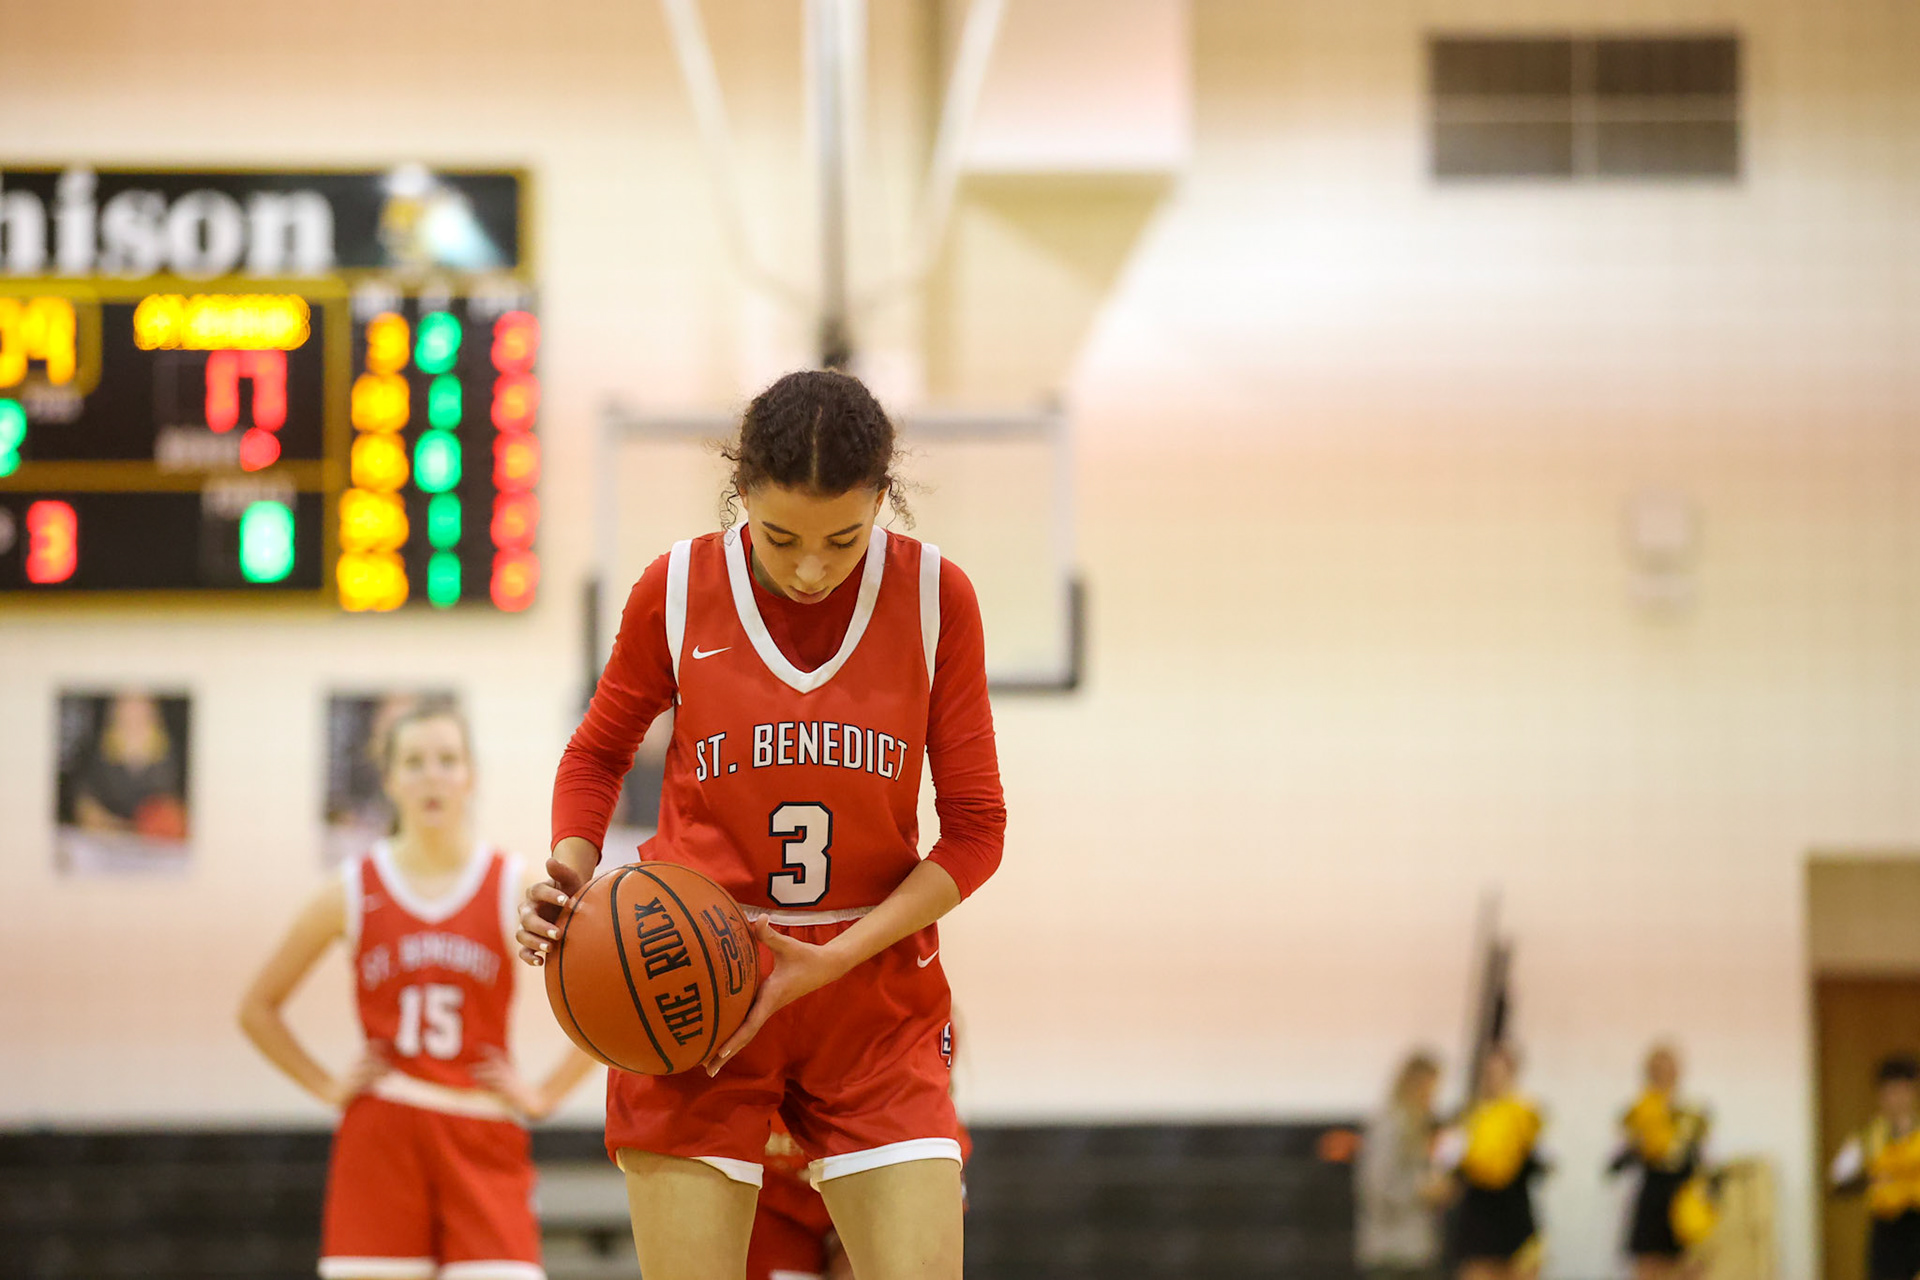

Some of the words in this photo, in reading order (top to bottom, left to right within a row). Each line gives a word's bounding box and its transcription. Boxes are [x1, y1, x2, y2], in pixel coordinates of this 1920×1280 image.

[695, 731, 738, 782] ST.
[752, 720, 908, 781] BENEDICT
[767, 801, 833, 908] 3
[634, 896, 692, 980] ROCK
[396, 982, 464, 1060] 15
[654, 982, 704, 1046] THE
